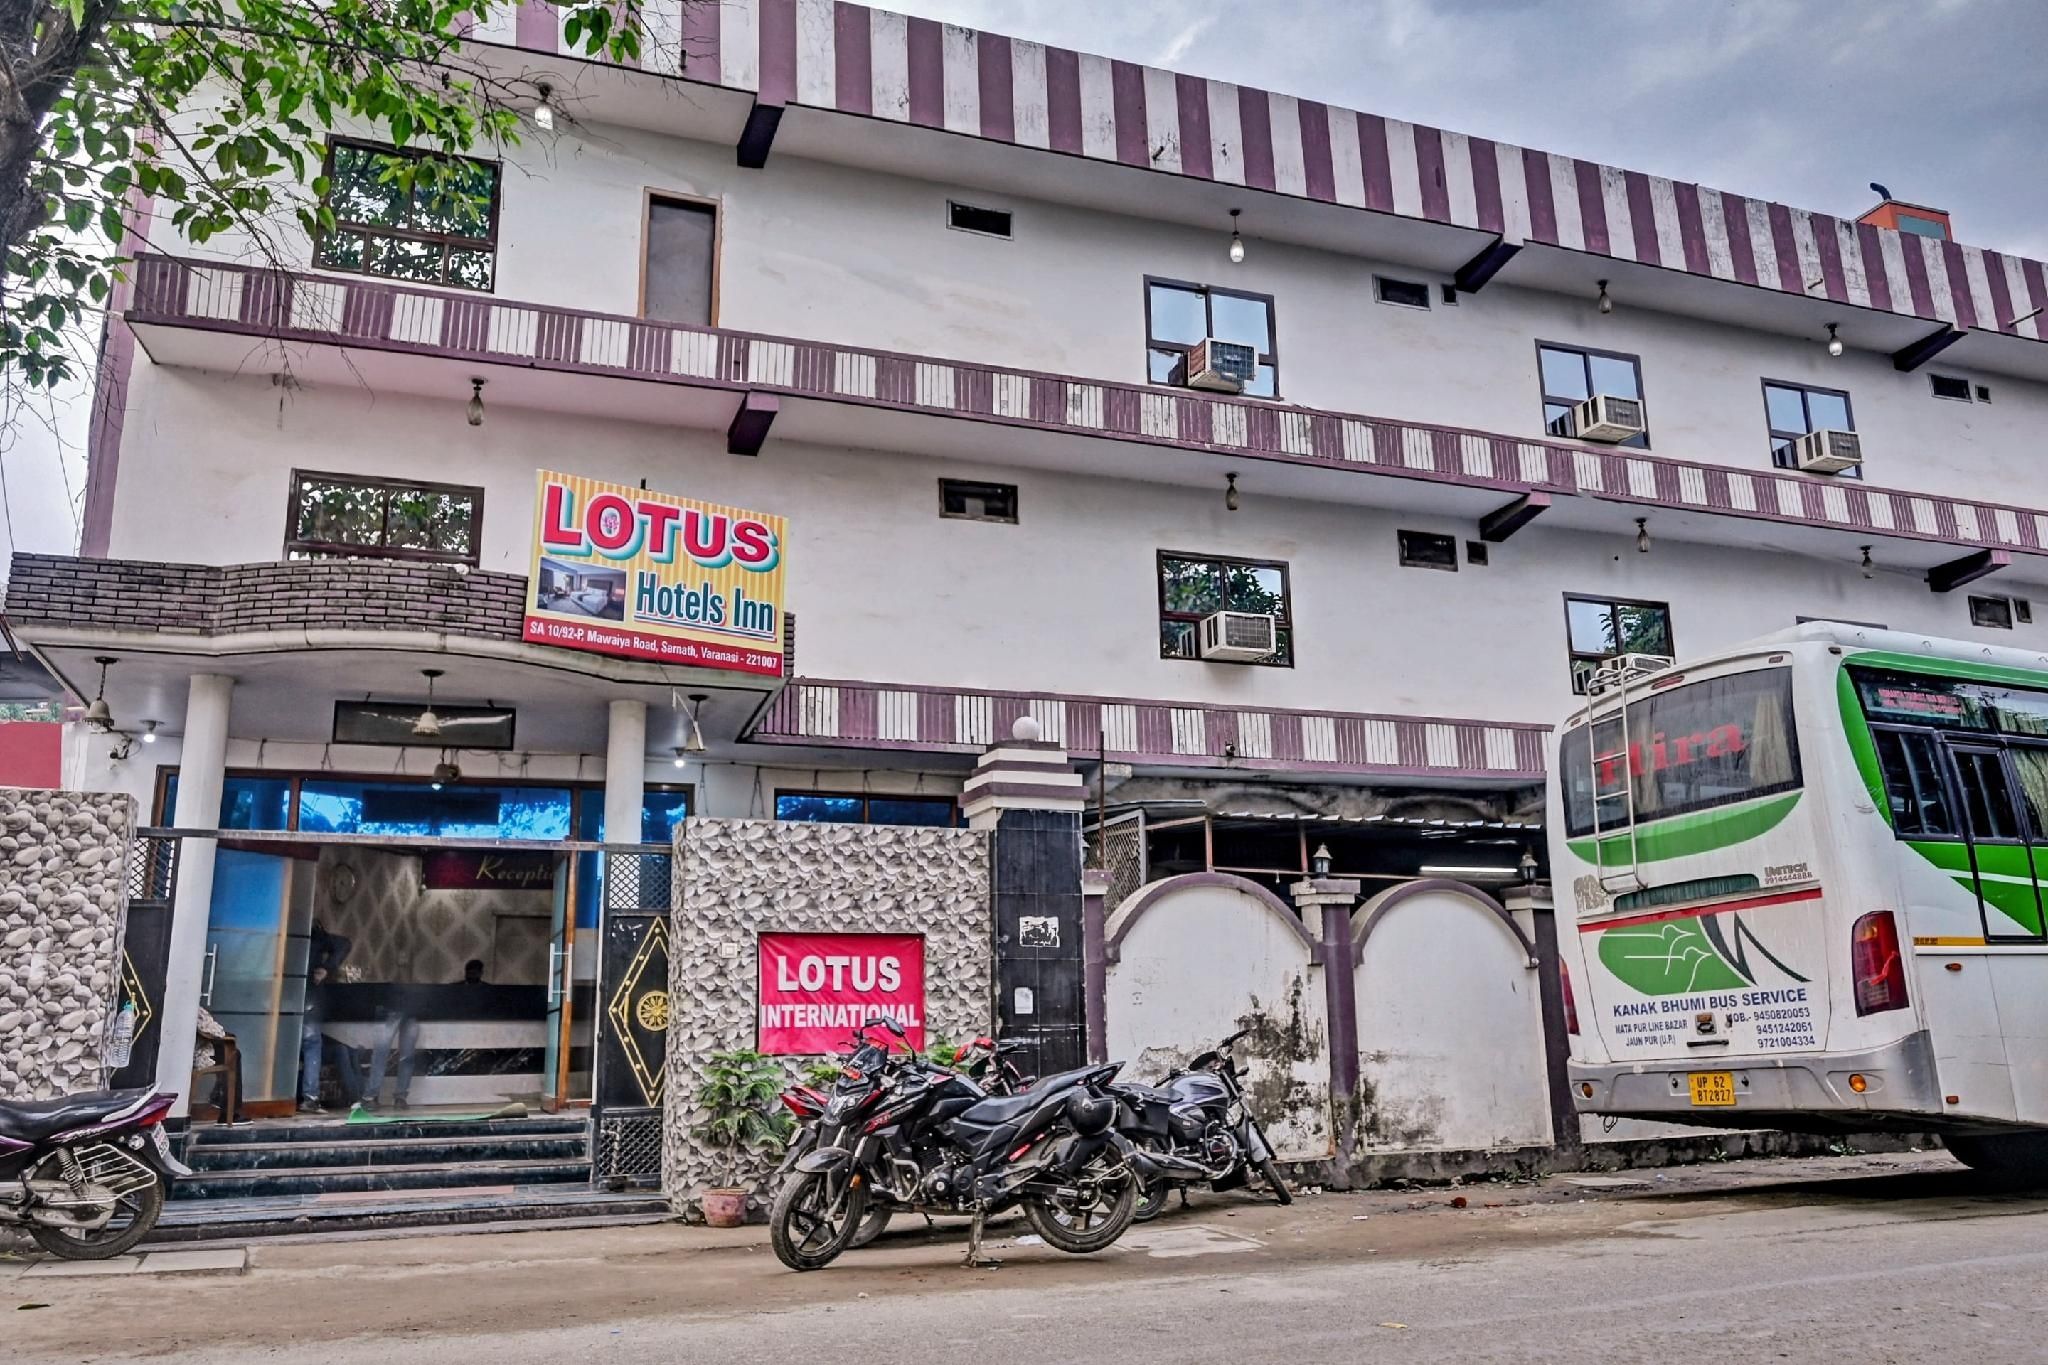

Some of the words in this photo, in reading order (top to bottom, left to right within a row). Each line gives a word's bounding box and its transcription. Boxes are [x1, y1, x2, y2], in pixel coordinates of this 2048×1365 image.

[542, 483, 776, 568] LOTUS
[636, 571, 724, 624] Hotels
[733, 587, 775, 632] Inn
[529, 621, 545, 635] SA
[587, 631, 630, 648] Mawaiya
[633, 638, 658, 653] Road,
[661, 641, 698, 658] Sarnath,
[701, 647, 738, 662] Varanasi
[746, 654, 777, 668] 221007
[777, 955, 901, 992] LOTUS
[1613, 1002, 1658, 1017] KANAK
[1661, 997, 1706, 1013] BHUMI
[1709, 994, 1738, 1008] BUS
[1742, 988, 1807, 1006] SERVICE
[761, 1004, 919, 1029] INTERNATIONAL
[1615, 1023, 1632, 1034] MATA
[1633, 1022, 1648, 1033] PUR
[1665, 1019, 1688, 1030] BAZAR
[1756, 1021, 1813, 1035] 9451242061
[1626, 1036, 1643, 1047] JAUN
[1644, 1035, 1658, 1046] PUR
[1757, 1035, 1815, 1048] 9721004334
[1696, 1076, 1708, 1089] UP
[1713, 1076, 1725, 1089] 62
